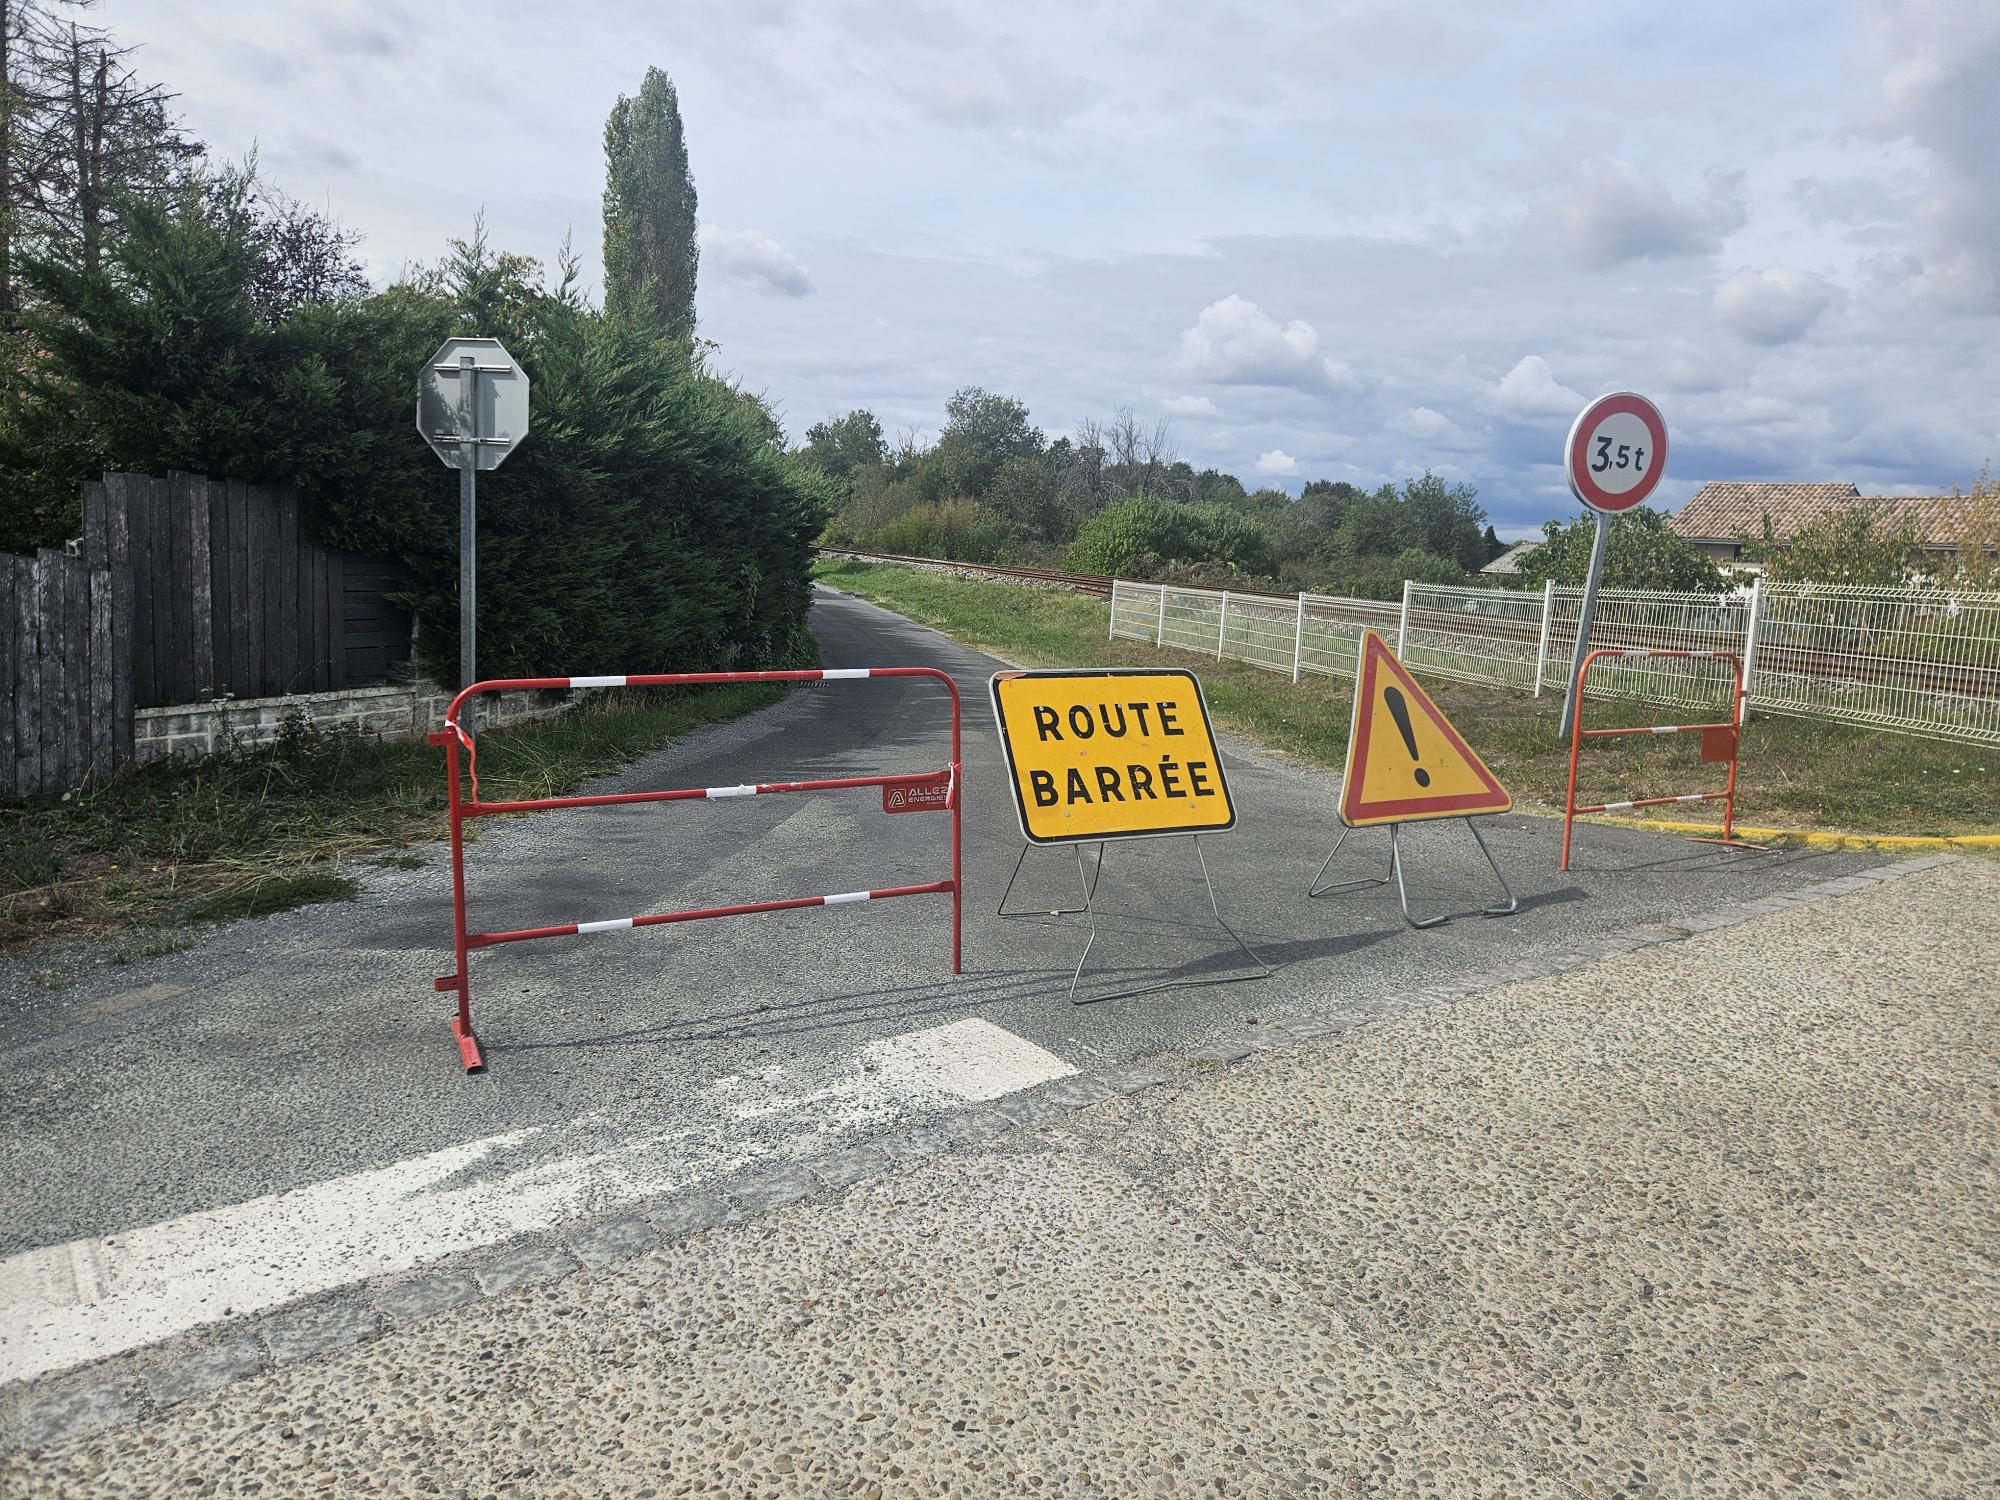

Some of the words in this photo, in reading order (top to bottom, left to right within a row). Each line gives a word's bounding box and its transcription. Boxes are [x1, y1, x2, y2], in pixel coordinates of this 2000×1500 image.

[1032, 701, 1185, 742] ROUTE
[908, 786, 948, 797] ALLEZ
[1029, 754, 1216, 808] BARRÉE
